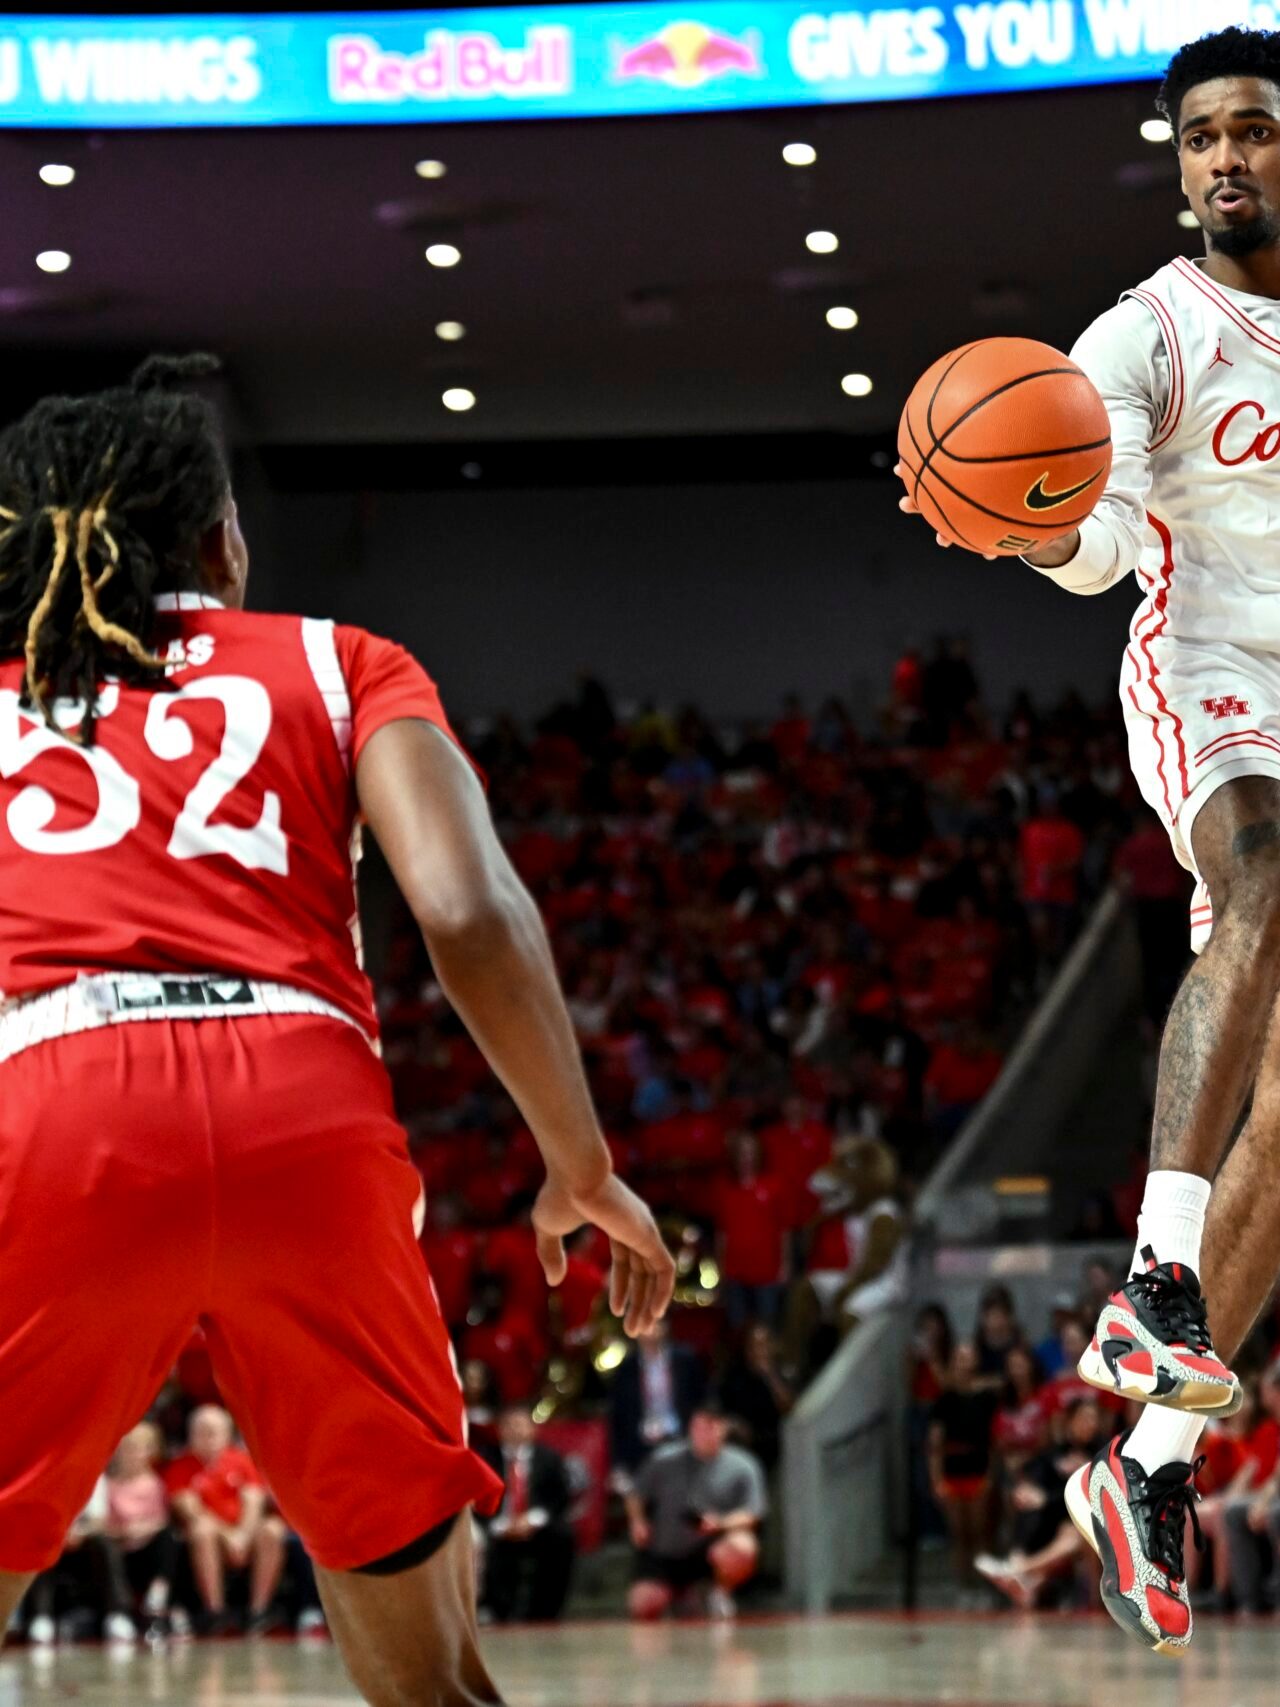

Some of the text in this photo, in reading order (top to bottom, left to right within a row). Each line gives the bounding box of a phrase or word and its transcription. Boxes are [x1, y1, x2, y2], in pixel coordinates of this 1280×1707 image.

[788, 7, 947, 81] GIVES
[954, 0, 1073, 70] YOU
[0, 676, 289, 876] 52
